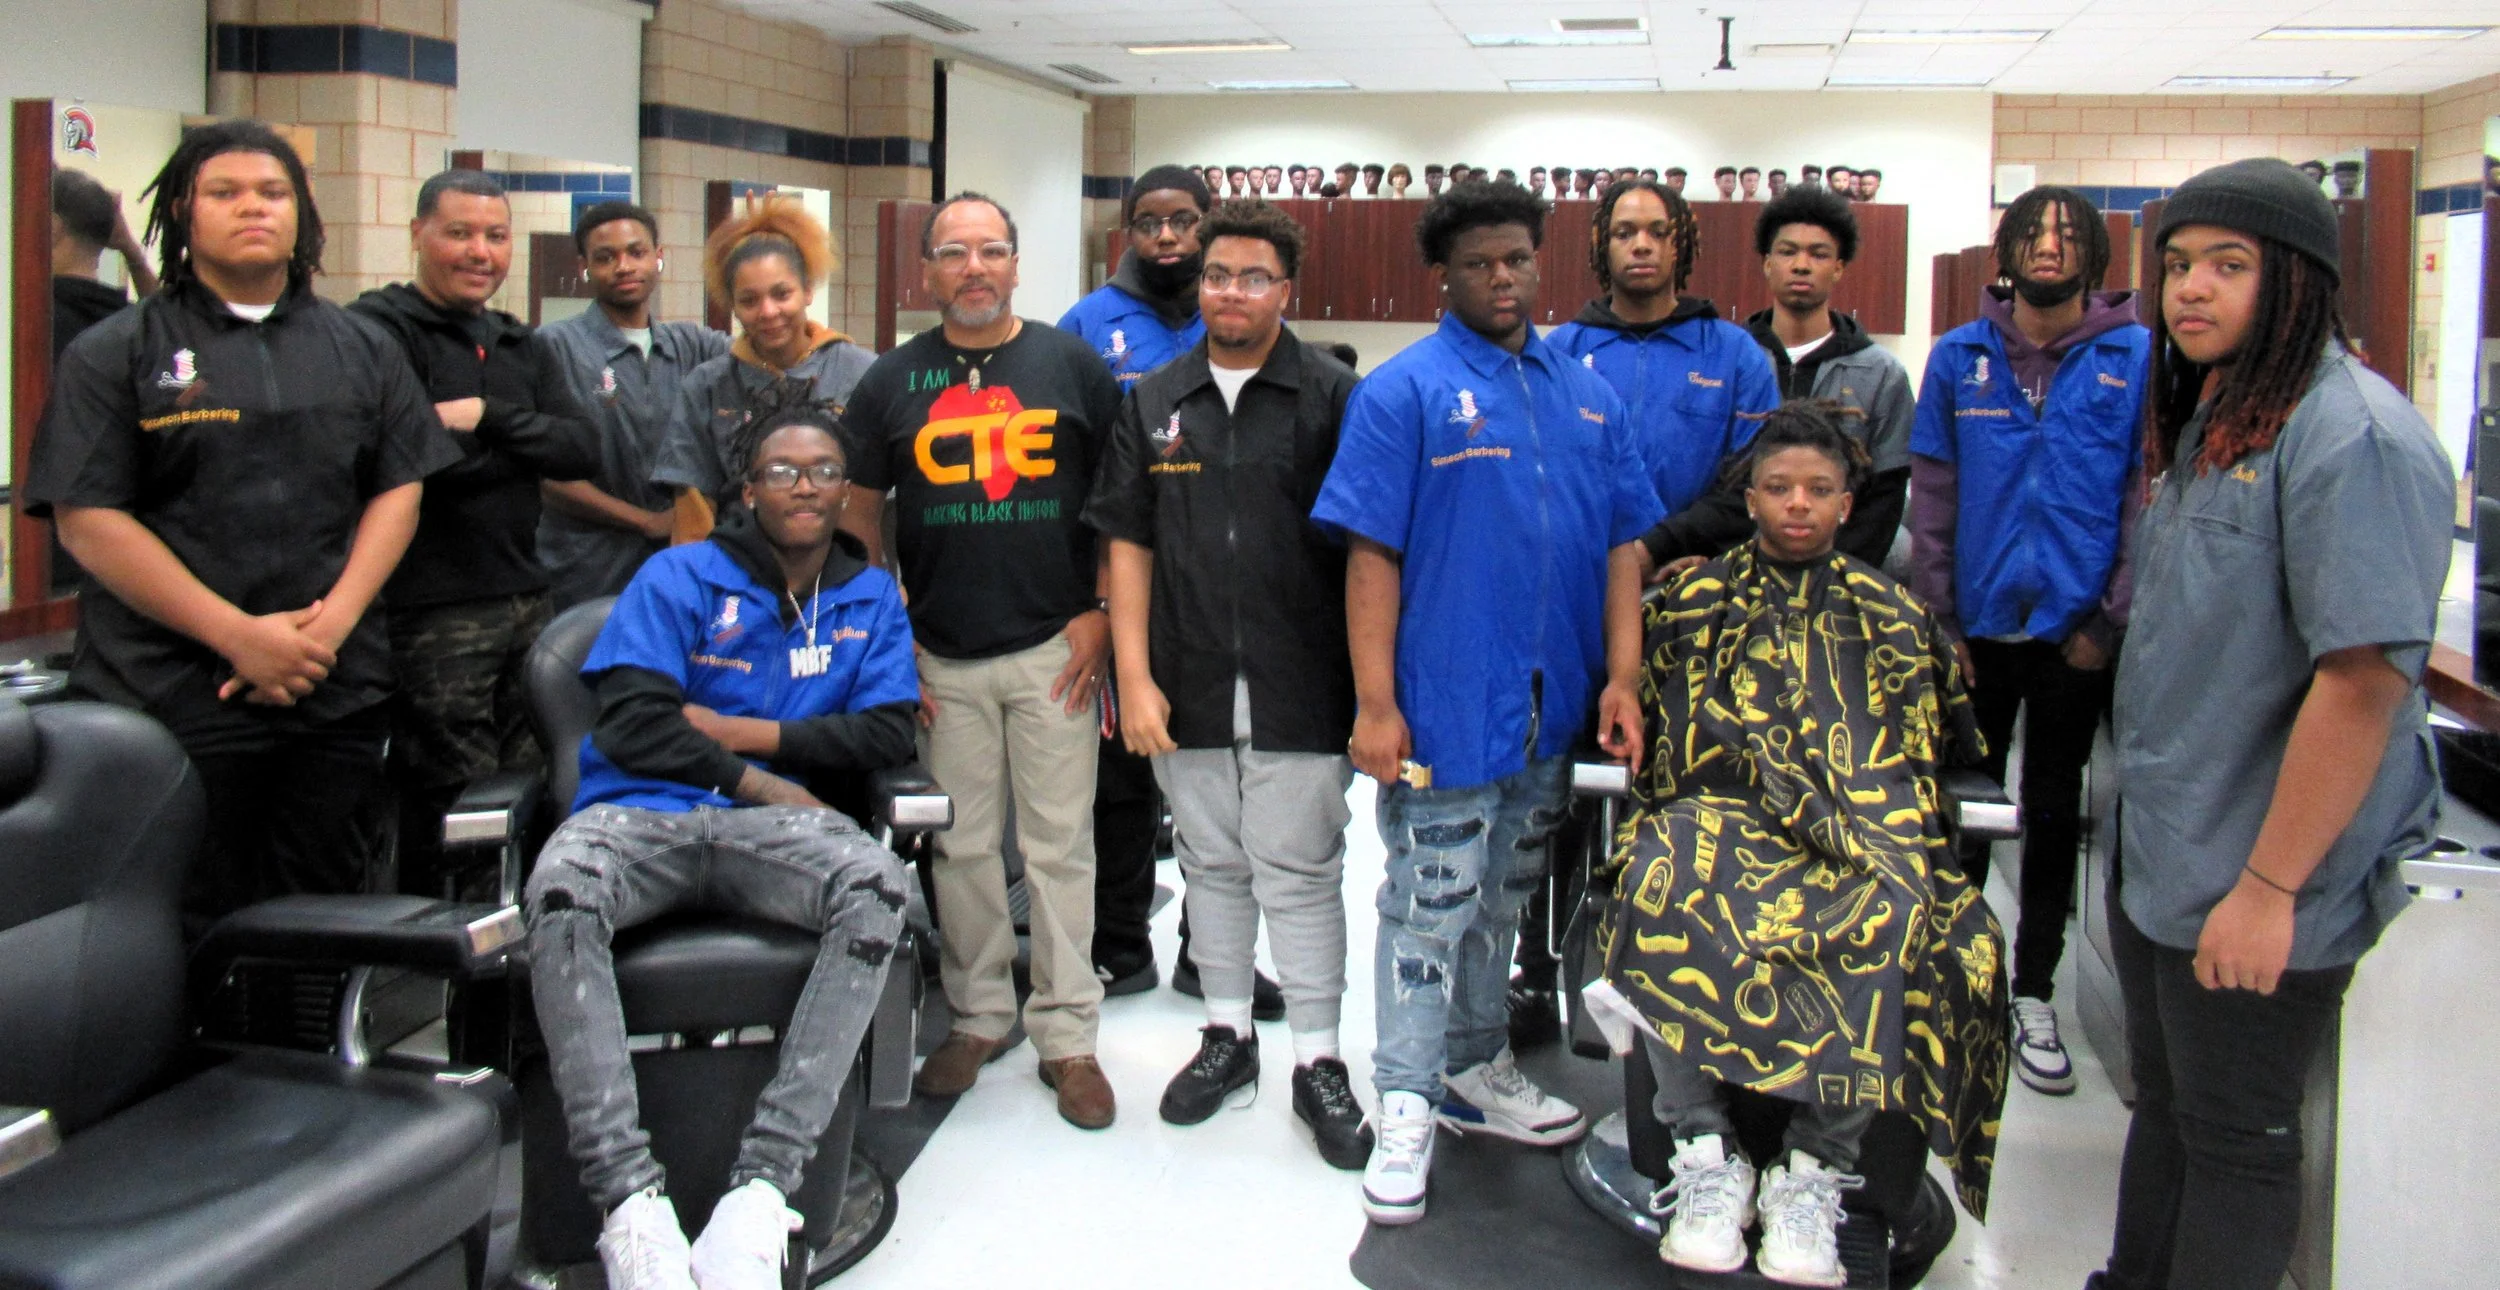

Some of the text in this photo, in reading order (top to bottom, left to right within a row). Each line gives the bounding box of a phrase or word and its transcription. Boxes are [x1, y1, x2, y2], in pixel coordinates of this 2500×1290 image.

[908, 368, 950, 393] I AM
[181, 407, 240, 424] Barbering
[914, 409, 1058, 485] CTE
[1431, 446, 1511, 467] Simeon Barbering
[971, 501, 1015, 524] BLACK
[1018, 499, 1060, 521] HISTORY
